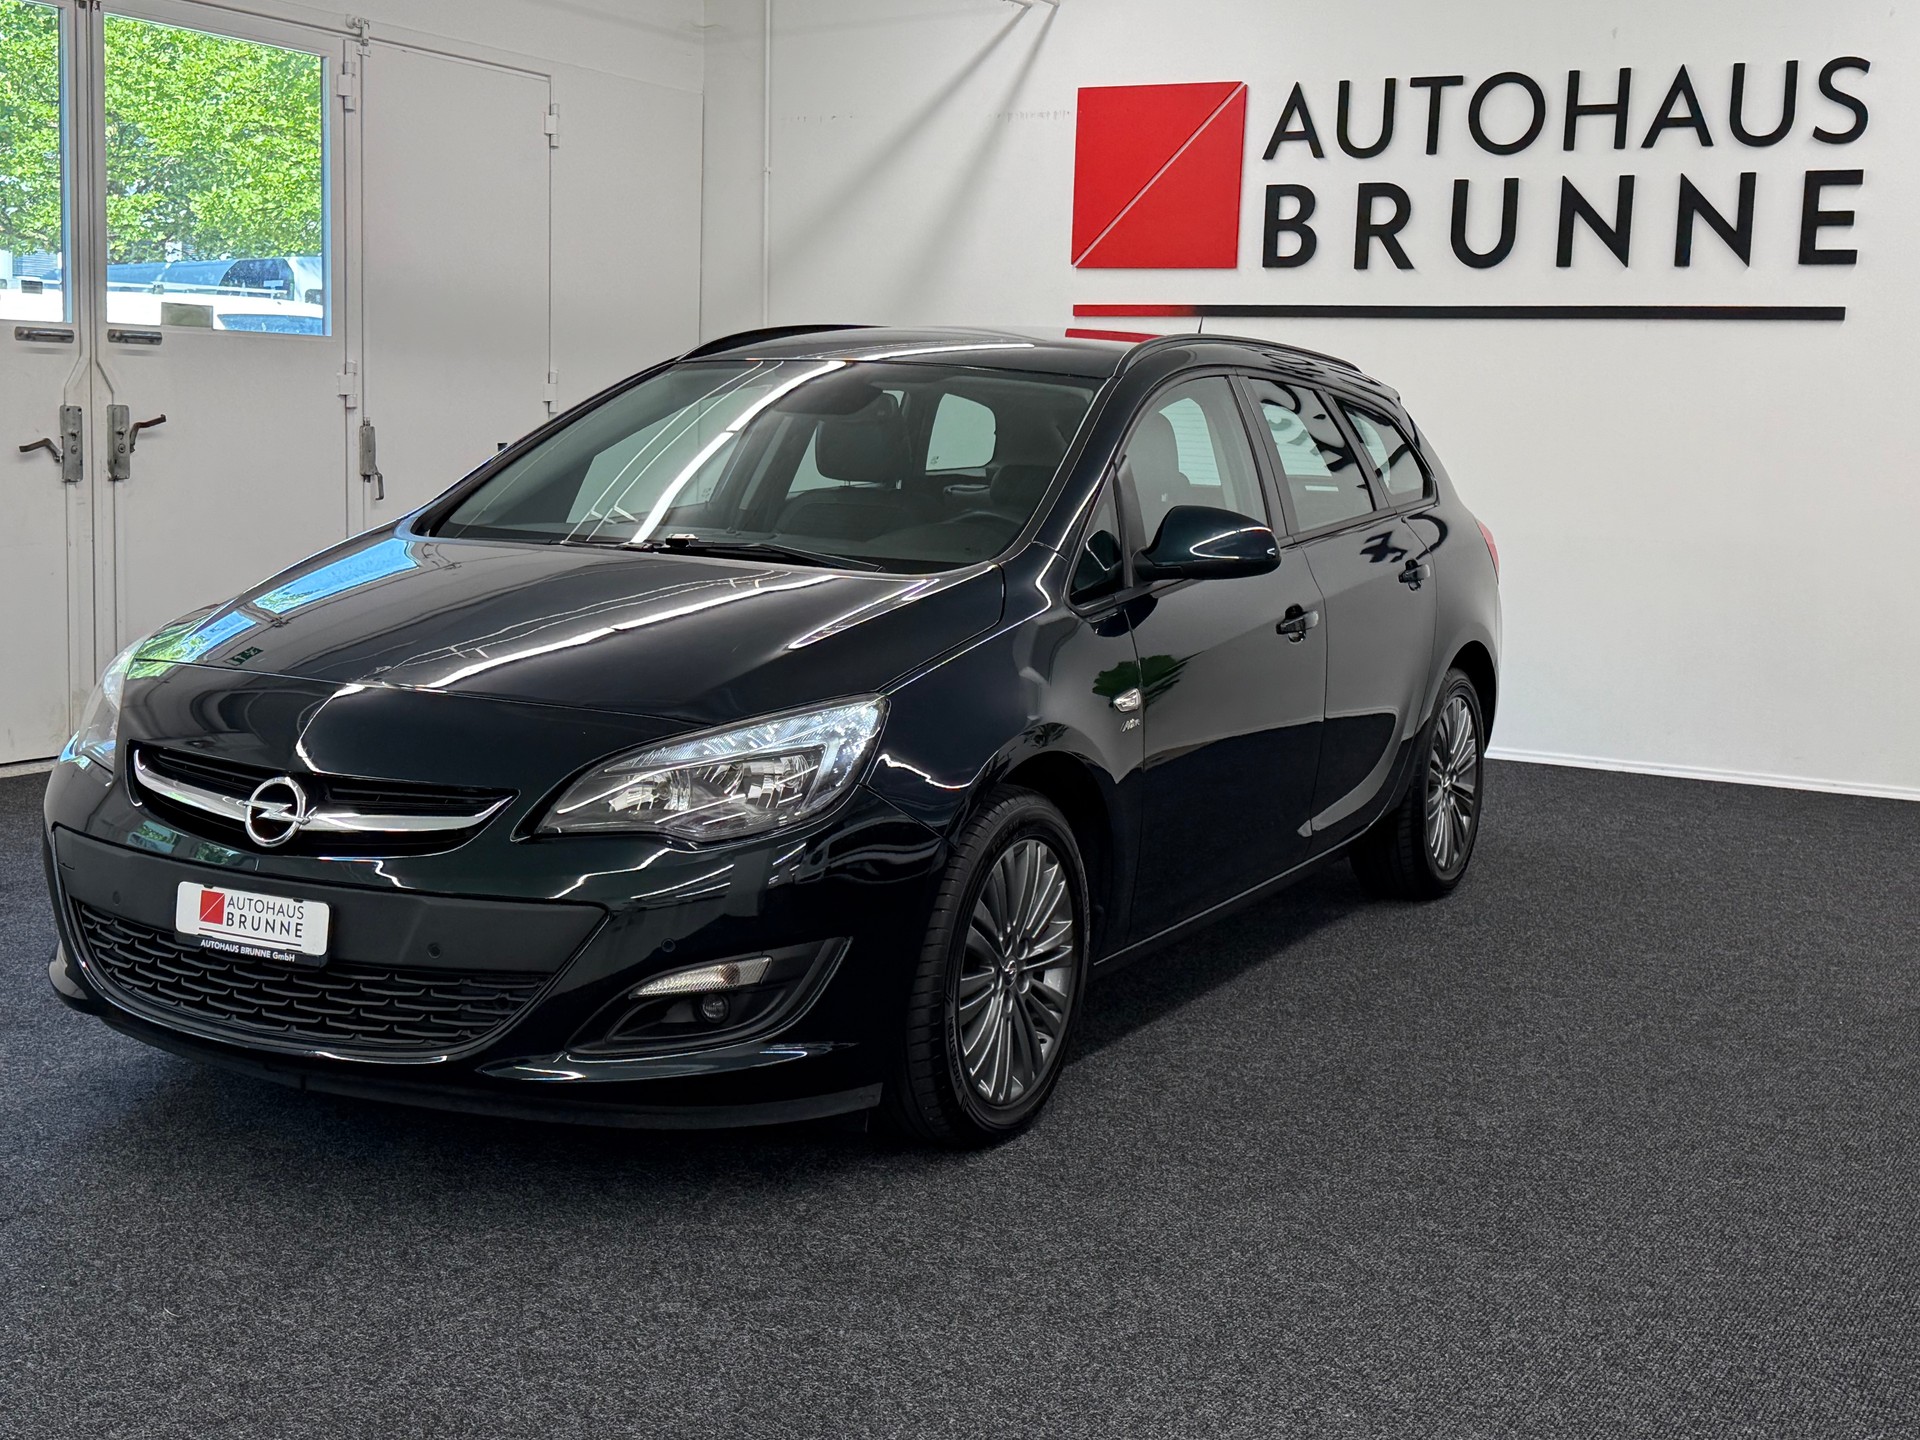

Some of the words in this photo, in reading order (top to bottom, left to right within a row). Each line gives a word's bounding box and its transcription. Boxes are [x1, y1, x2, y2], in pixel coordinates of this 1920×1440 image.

[1263, 56, 1871, 160] AUTOHAUS
[1262, 169, 1864, 270] BRUNNE
[227, 896, 304, 919] AUTOHAUS
[226, 912, 304, 938] BRUNNE
[200, 939, 239, 952] AUTOHAUS
[240, 947, 271, 958] BRUNNE
[272, 951, 296, 962] GmbH
